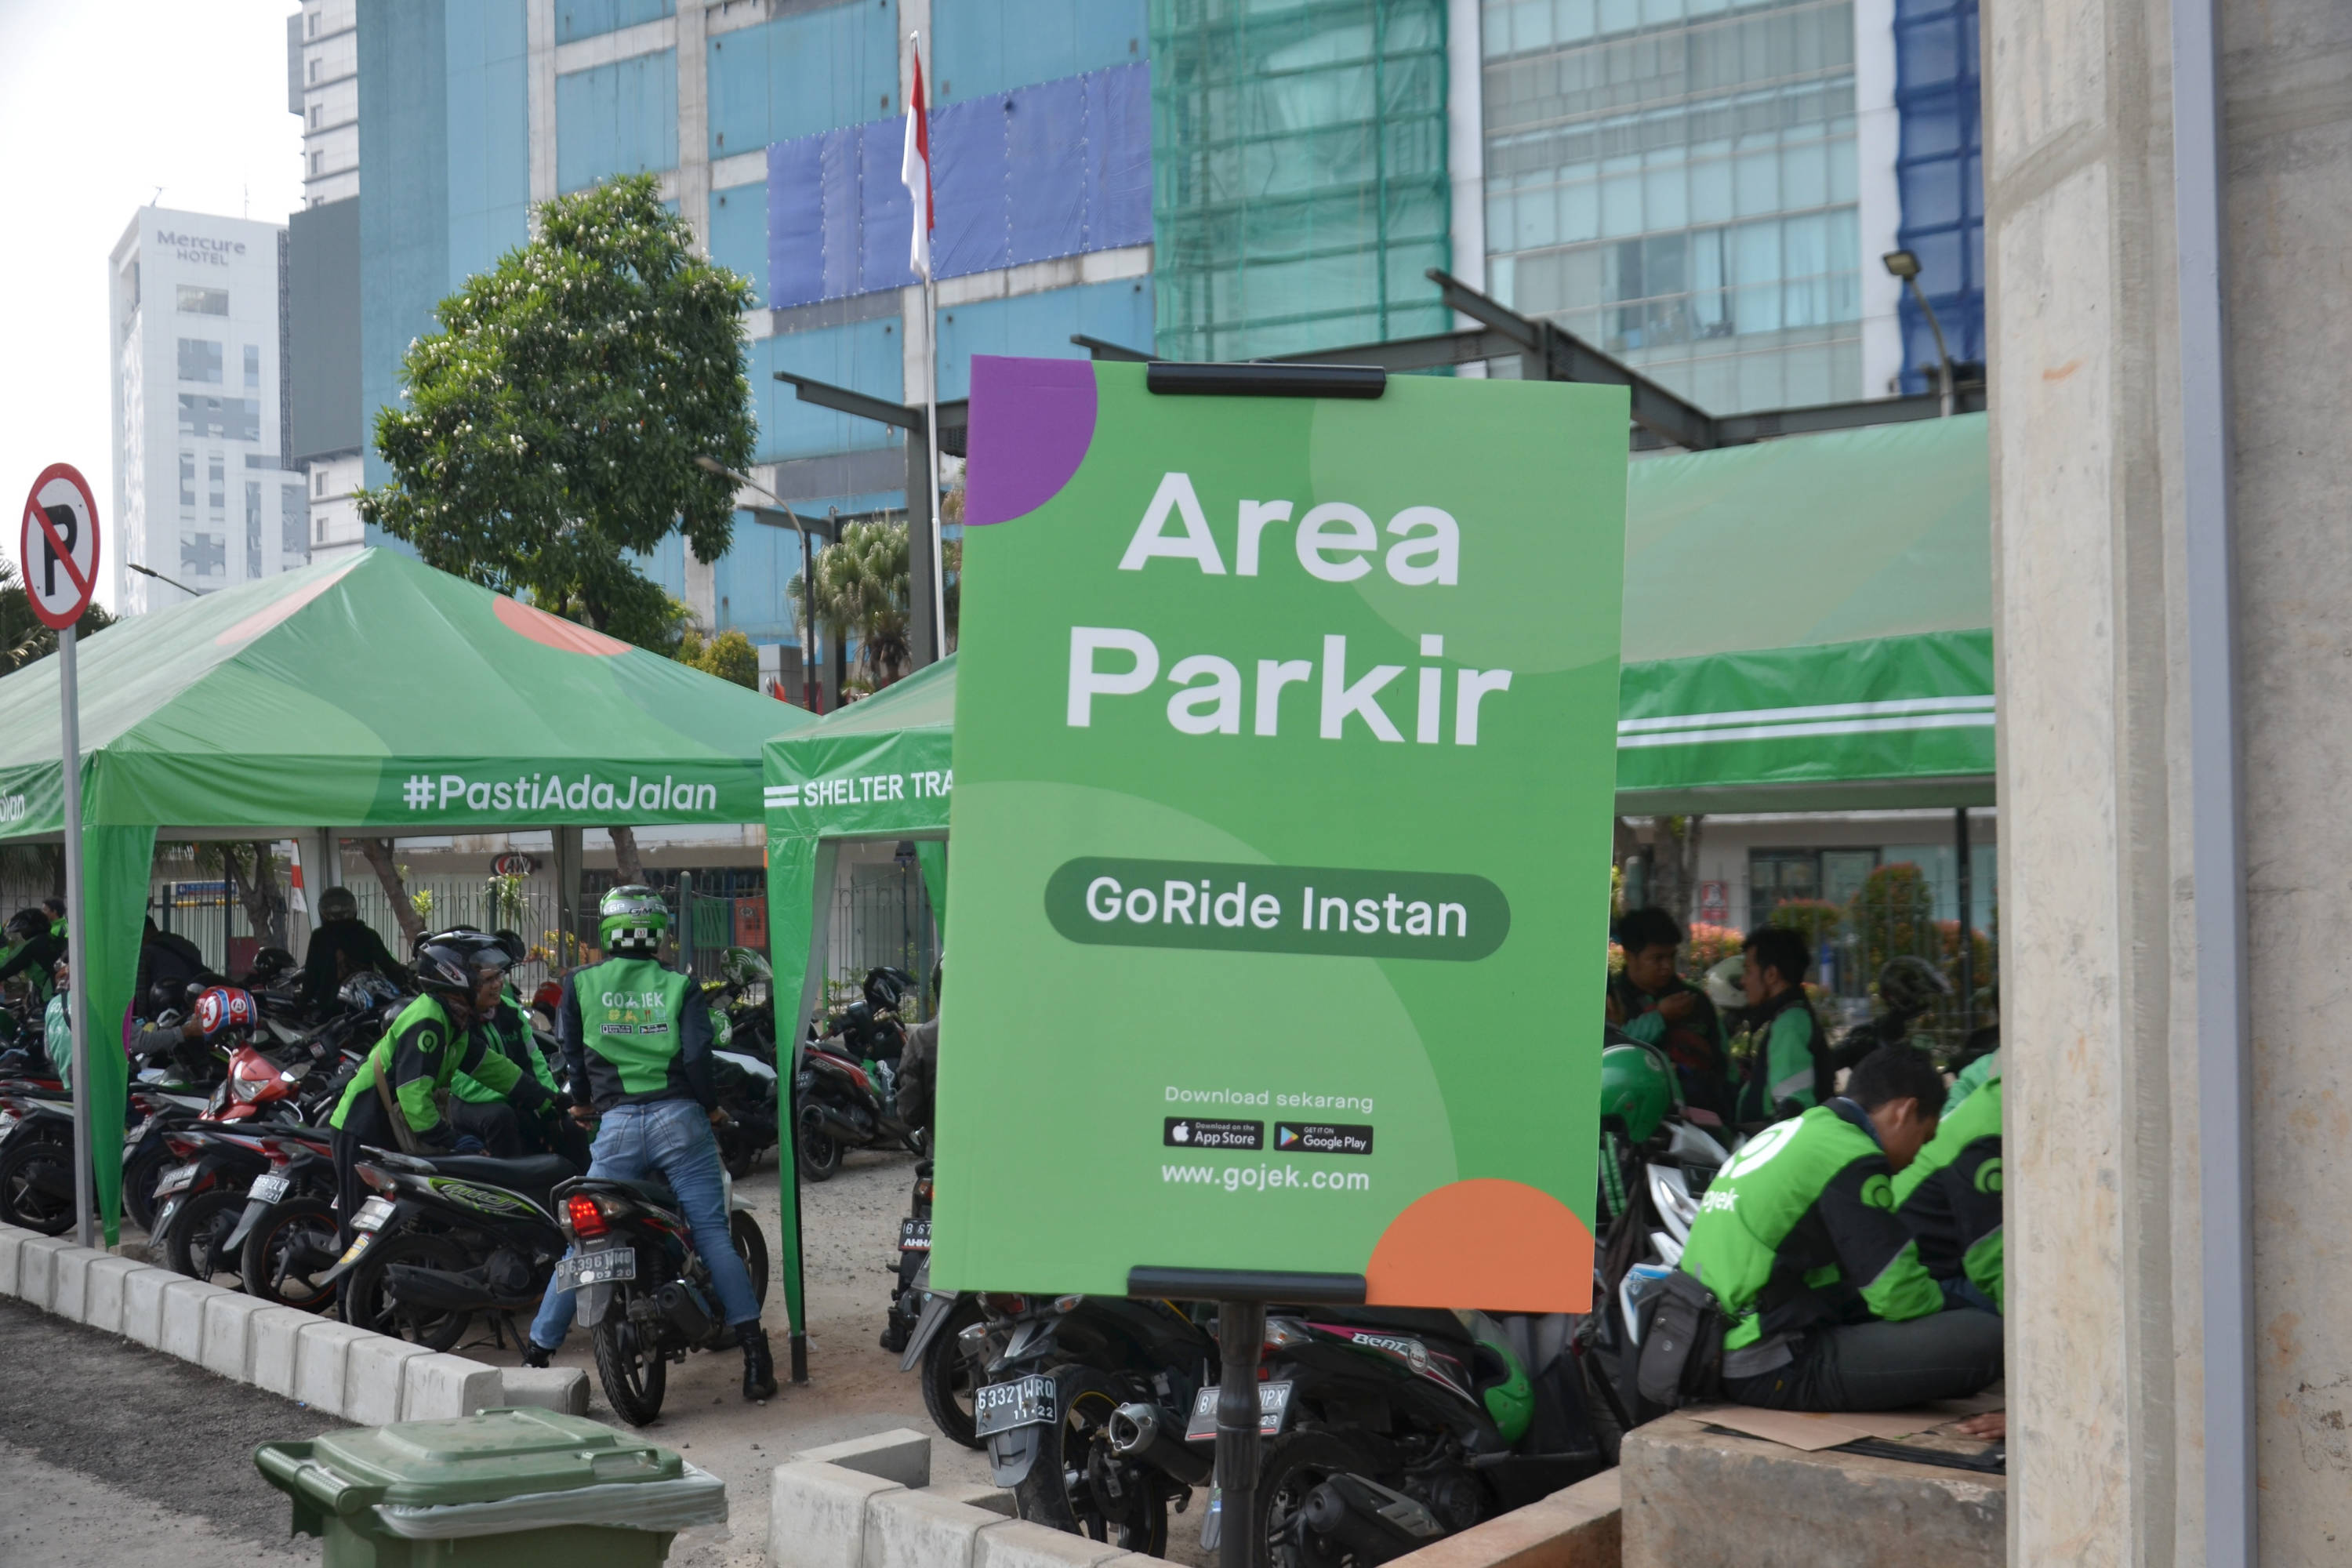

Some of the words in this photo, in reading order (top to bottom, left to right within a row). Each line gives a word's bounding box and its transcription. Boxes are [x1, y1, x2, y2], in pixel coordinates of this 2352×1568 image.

[157, 230, 245, 254] Mercure
[177, 249, 228, 265] HOTEL
[1118, 472, 1460, 586] Area
[43, 503, 78, 597] P
[1067, 626, 1512, 746] Parkir
[403, 772, 717, 810] #PastiAdaJalan
[804, 774, 904, 807] SHELTER
[1086, 877, 1280, 928] GoRide
[1302, 887, 1468, 937] Instan
[1165, 1087, 1269, 1105] Download
[1276, 1092, 1374, 1114] sekarang
[1194, 1131, 1220, 1145] App
[1222, 1132, 1255, 1145] Store
[1303, 1134, 1342, 1149] Google
[1344, 1137, 1367, 1150] Play
[1162, 1163, 1369, 1191] www.gojek.com
[906, 1223, 913, 1234] B
[978, 1385, 1015, 1410] 6332
[1200, 1396, 1209, 1412] B
